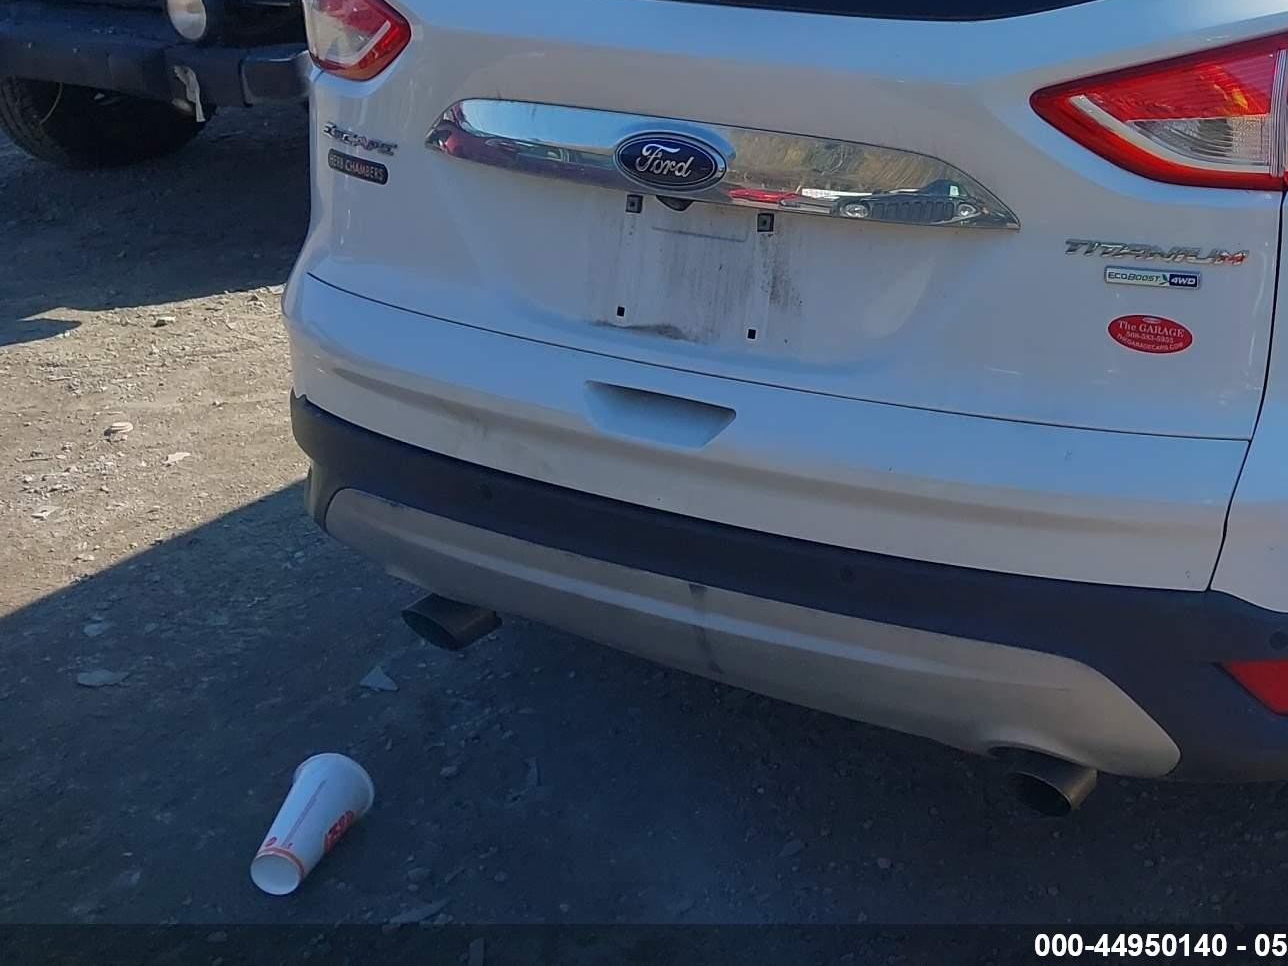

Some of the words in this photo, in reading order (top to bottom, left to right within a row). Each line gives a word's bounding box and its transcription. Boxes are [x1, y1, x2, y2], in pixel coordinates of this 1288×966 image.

[345, 159, 386, 180] CHAMBERS
[635, 143, 694, 178] Ford
[1065, 239, 1249, 265] TITANIUM
[1170, 275, 1197, 285] 4WD
[1119, 321, 1137, 332] The
[1139, 323, 1185, 338] GARAGE
